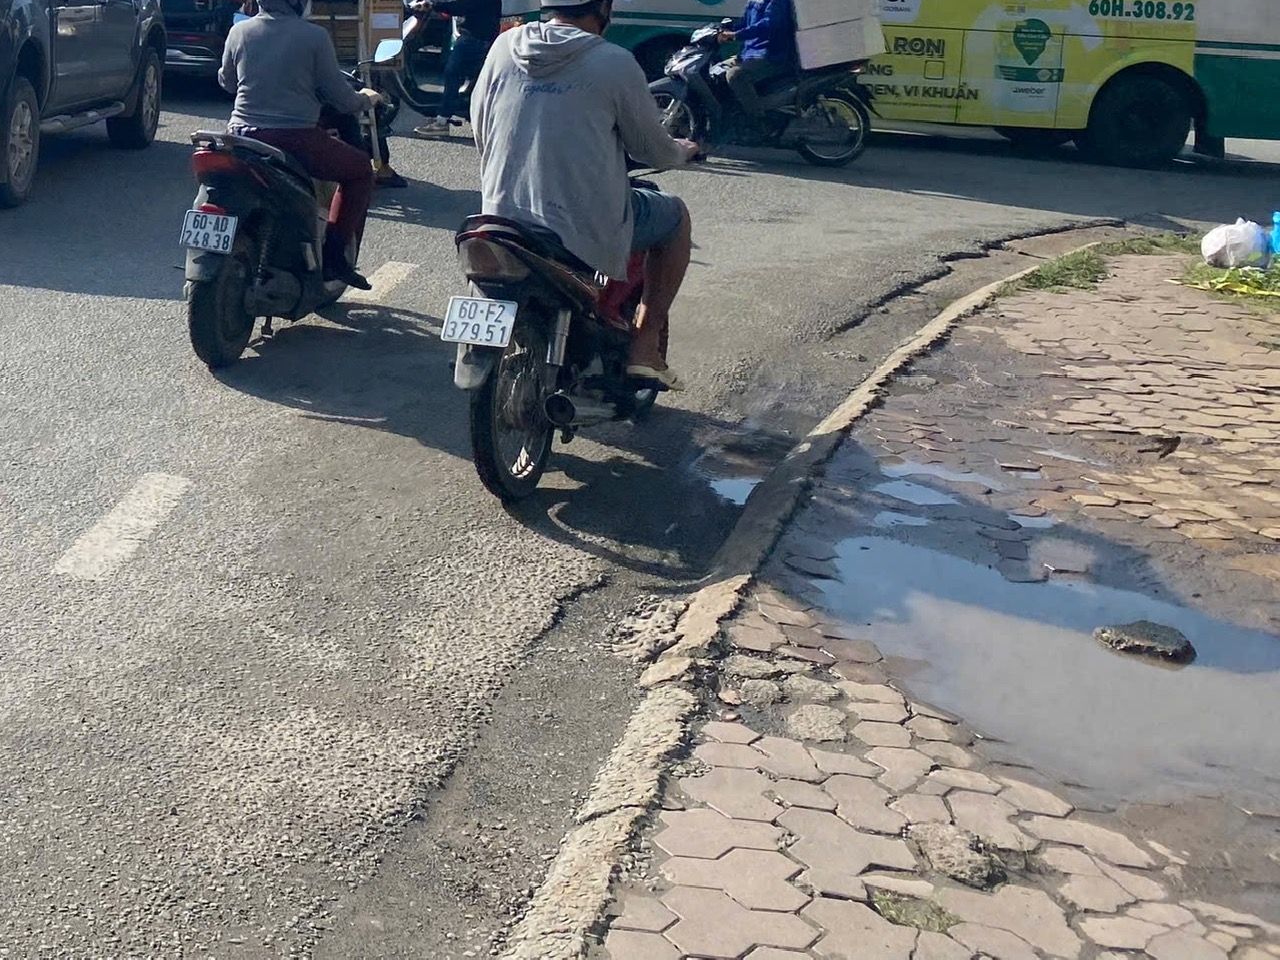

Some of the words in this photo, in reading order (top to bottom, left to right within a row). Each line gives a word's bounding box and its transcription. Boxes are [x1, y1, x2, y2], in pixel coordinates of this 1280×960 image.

[903, 86, 918, 97] VI
[184, 230, 231, 251] 248.38
[447, 321, 507, 343] 379.51
